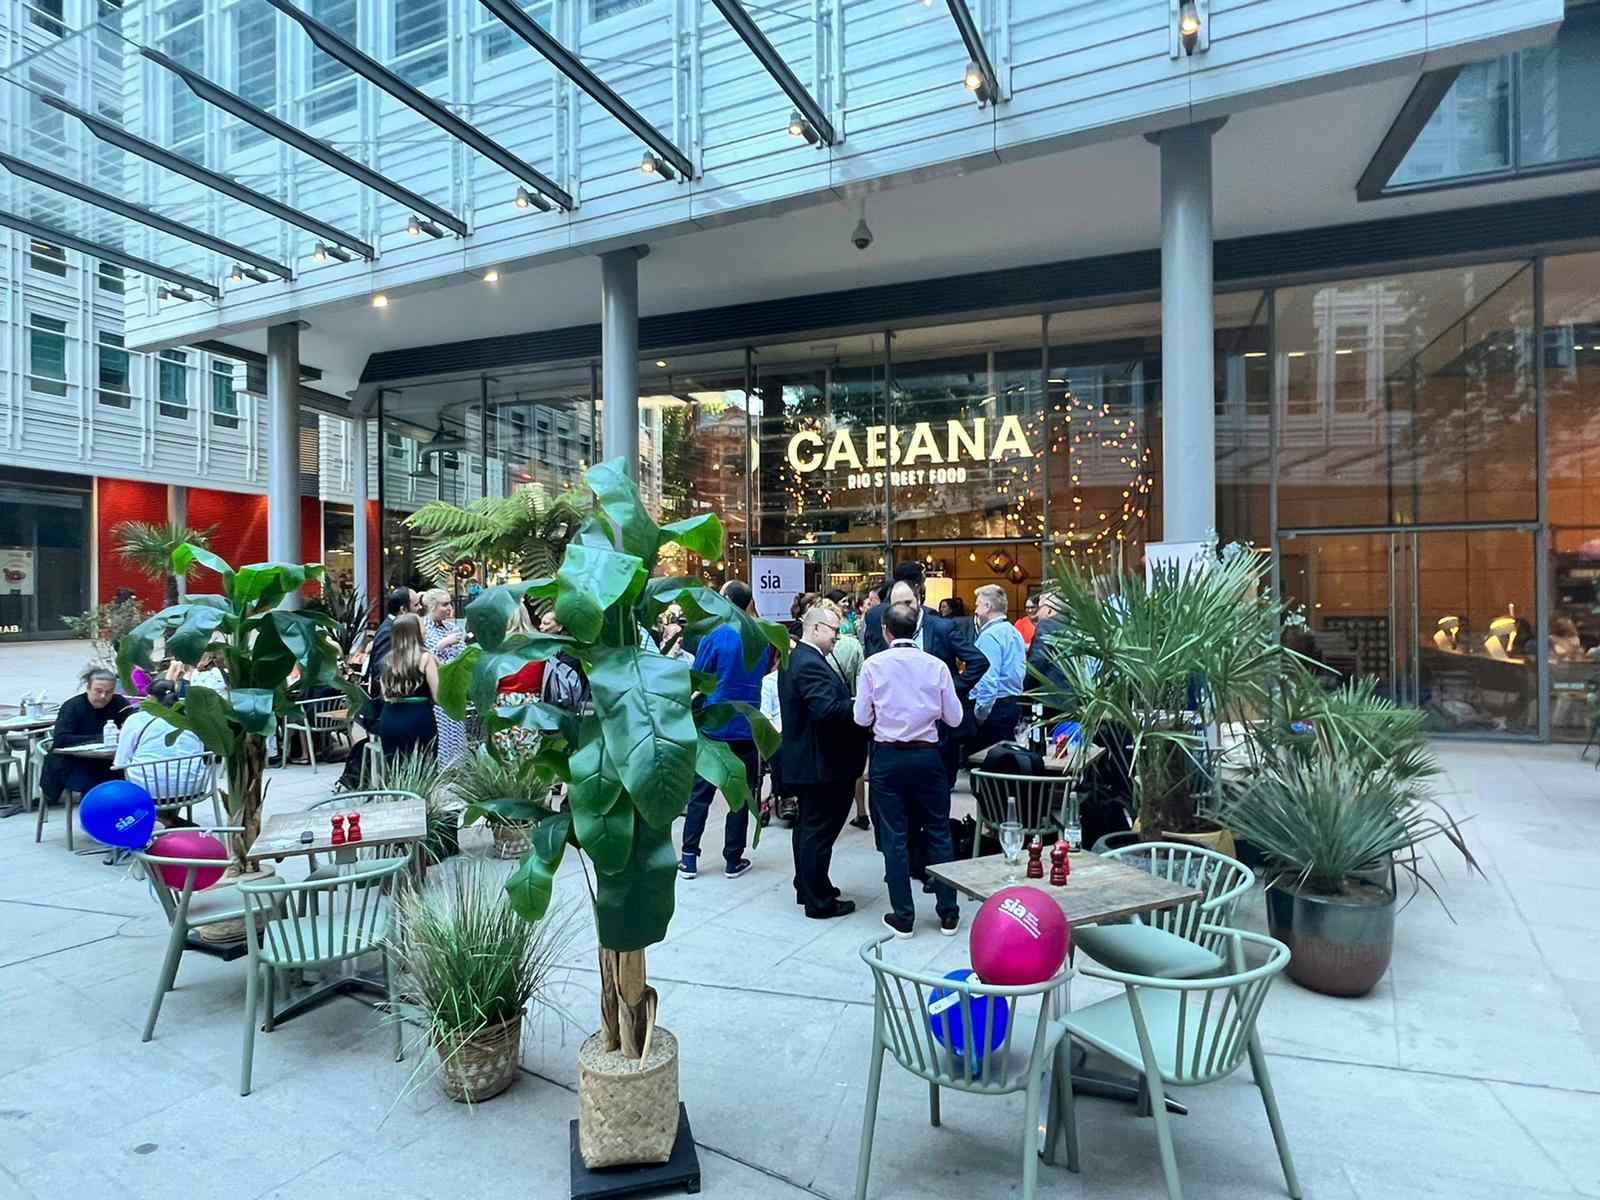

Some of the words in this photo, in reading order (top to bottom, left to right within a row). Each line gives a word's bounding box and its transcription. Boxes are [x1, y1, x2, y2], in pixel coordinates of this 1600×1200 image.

[787, 415, 1034, 473] CABANA
[848, 473, 871, 489] RIO
[874, 470, 925, 488] SREET
[929, 467, 966, 484] FOOD
[760, 570, 781, 589] sia
[115, 815, 136, 832] sia
[1000, 898, 1027, 919] sia
